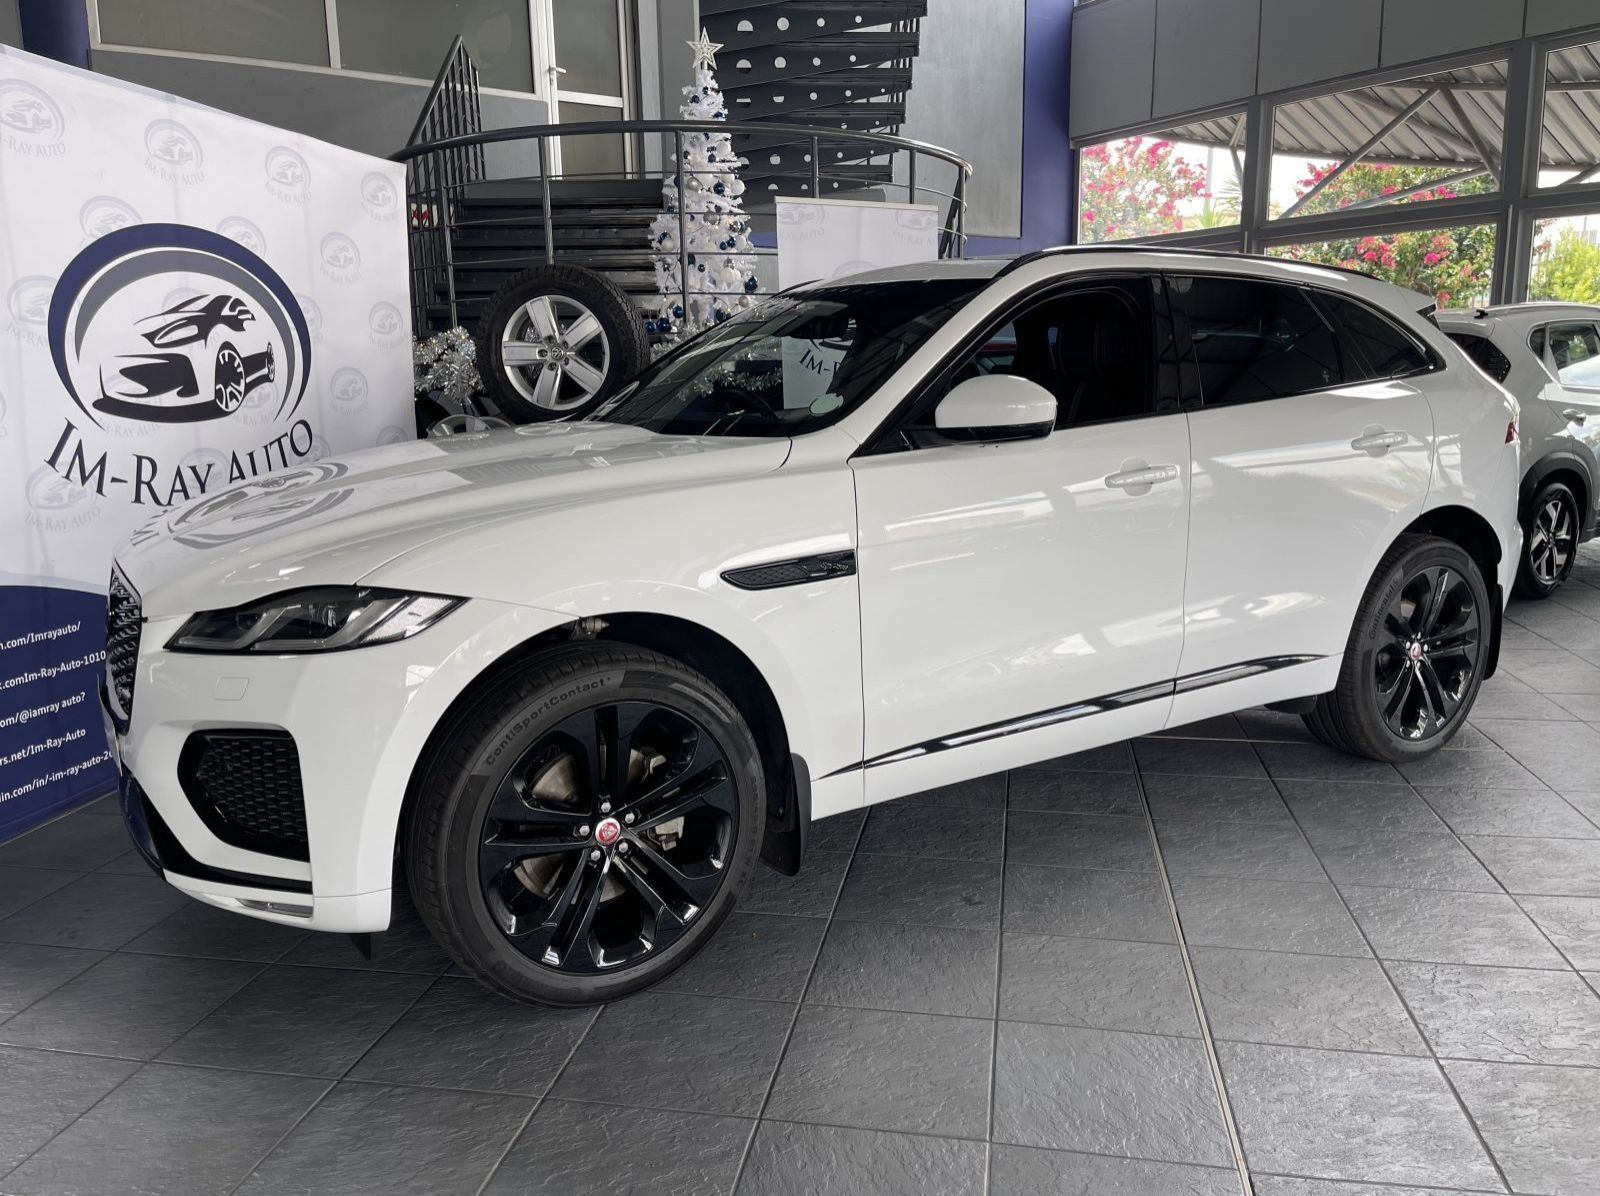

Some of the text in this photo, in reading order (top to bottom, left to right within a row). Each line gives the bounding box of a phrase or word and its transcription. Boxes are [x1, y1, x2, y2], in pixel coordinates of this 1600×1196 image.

[0, 134, 33, 155] -RAY
[44, 417, 313, 507] IM-RAY AUTO
[486, 677, 607, 766] ContiSportContact
